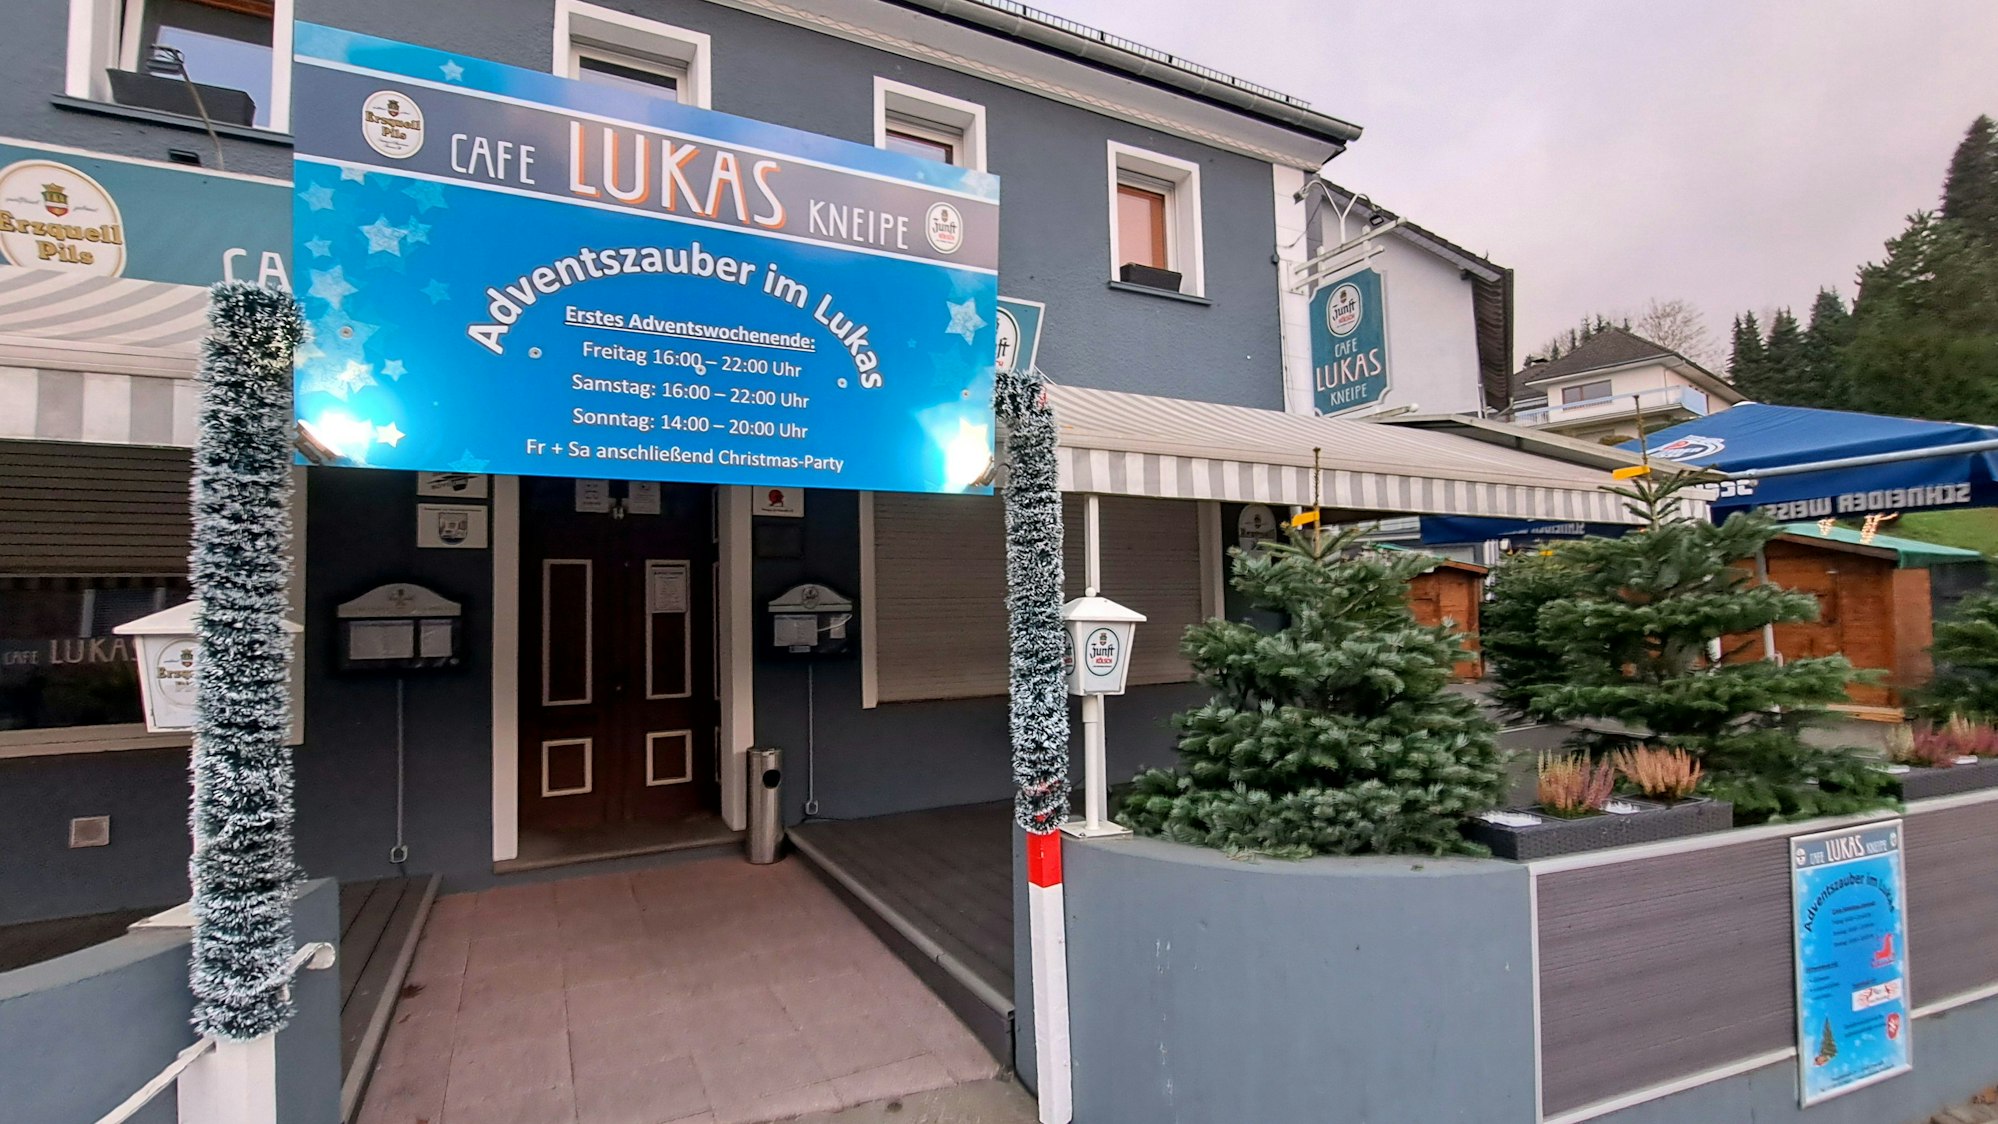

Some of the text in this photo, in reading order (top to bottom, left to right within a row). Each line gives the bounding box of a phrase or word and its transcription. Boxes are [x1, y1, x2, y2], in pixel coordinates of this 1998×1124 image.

[381, 126, 407, 140] Pils
[451, 120, 909, 250] CAFE LUKAS KNEIPE
[0, 210, 122, 245] Erzquell
[35, 240, 95, 265] Pils
[467, 241, 882, 389] Adventszauber im Lukas
[565, 306, 816, 350] Erstes Adventswochenende:
[582, 341, 647, 366] Freitag
[653, 349, 702, 367] 16:00
[721, 356, 768, 375] 22:00
[772, 361, 802, 378] Uhr
[1335, 338, 1358, 358] CAFE
[1316, 348, 1382, 392] LUKAS
[572, 374, 656, 399] Samstag:
[662, 382, 710, 401] 16:00
[730, 388, 776, 406] 22:00
[780, 393, 810, 409] Uhr
[1331, 382, 1367, 406] KNEIPE
[572, 407, 655, 433] Sonntag:
[661, 414, 709, 433] 14:00
[729, 419, 774, 438] 20:00
[779, 423, 808, 439] Uhr
[526, 438, 844, 473] Fr + Sa anschließend Christmas-Party
[49, 638, 137, 664] LUKA
[1825, 834, 1865, 862] LUKAS
[1804, 872, 1864, 932] Adventszauber
